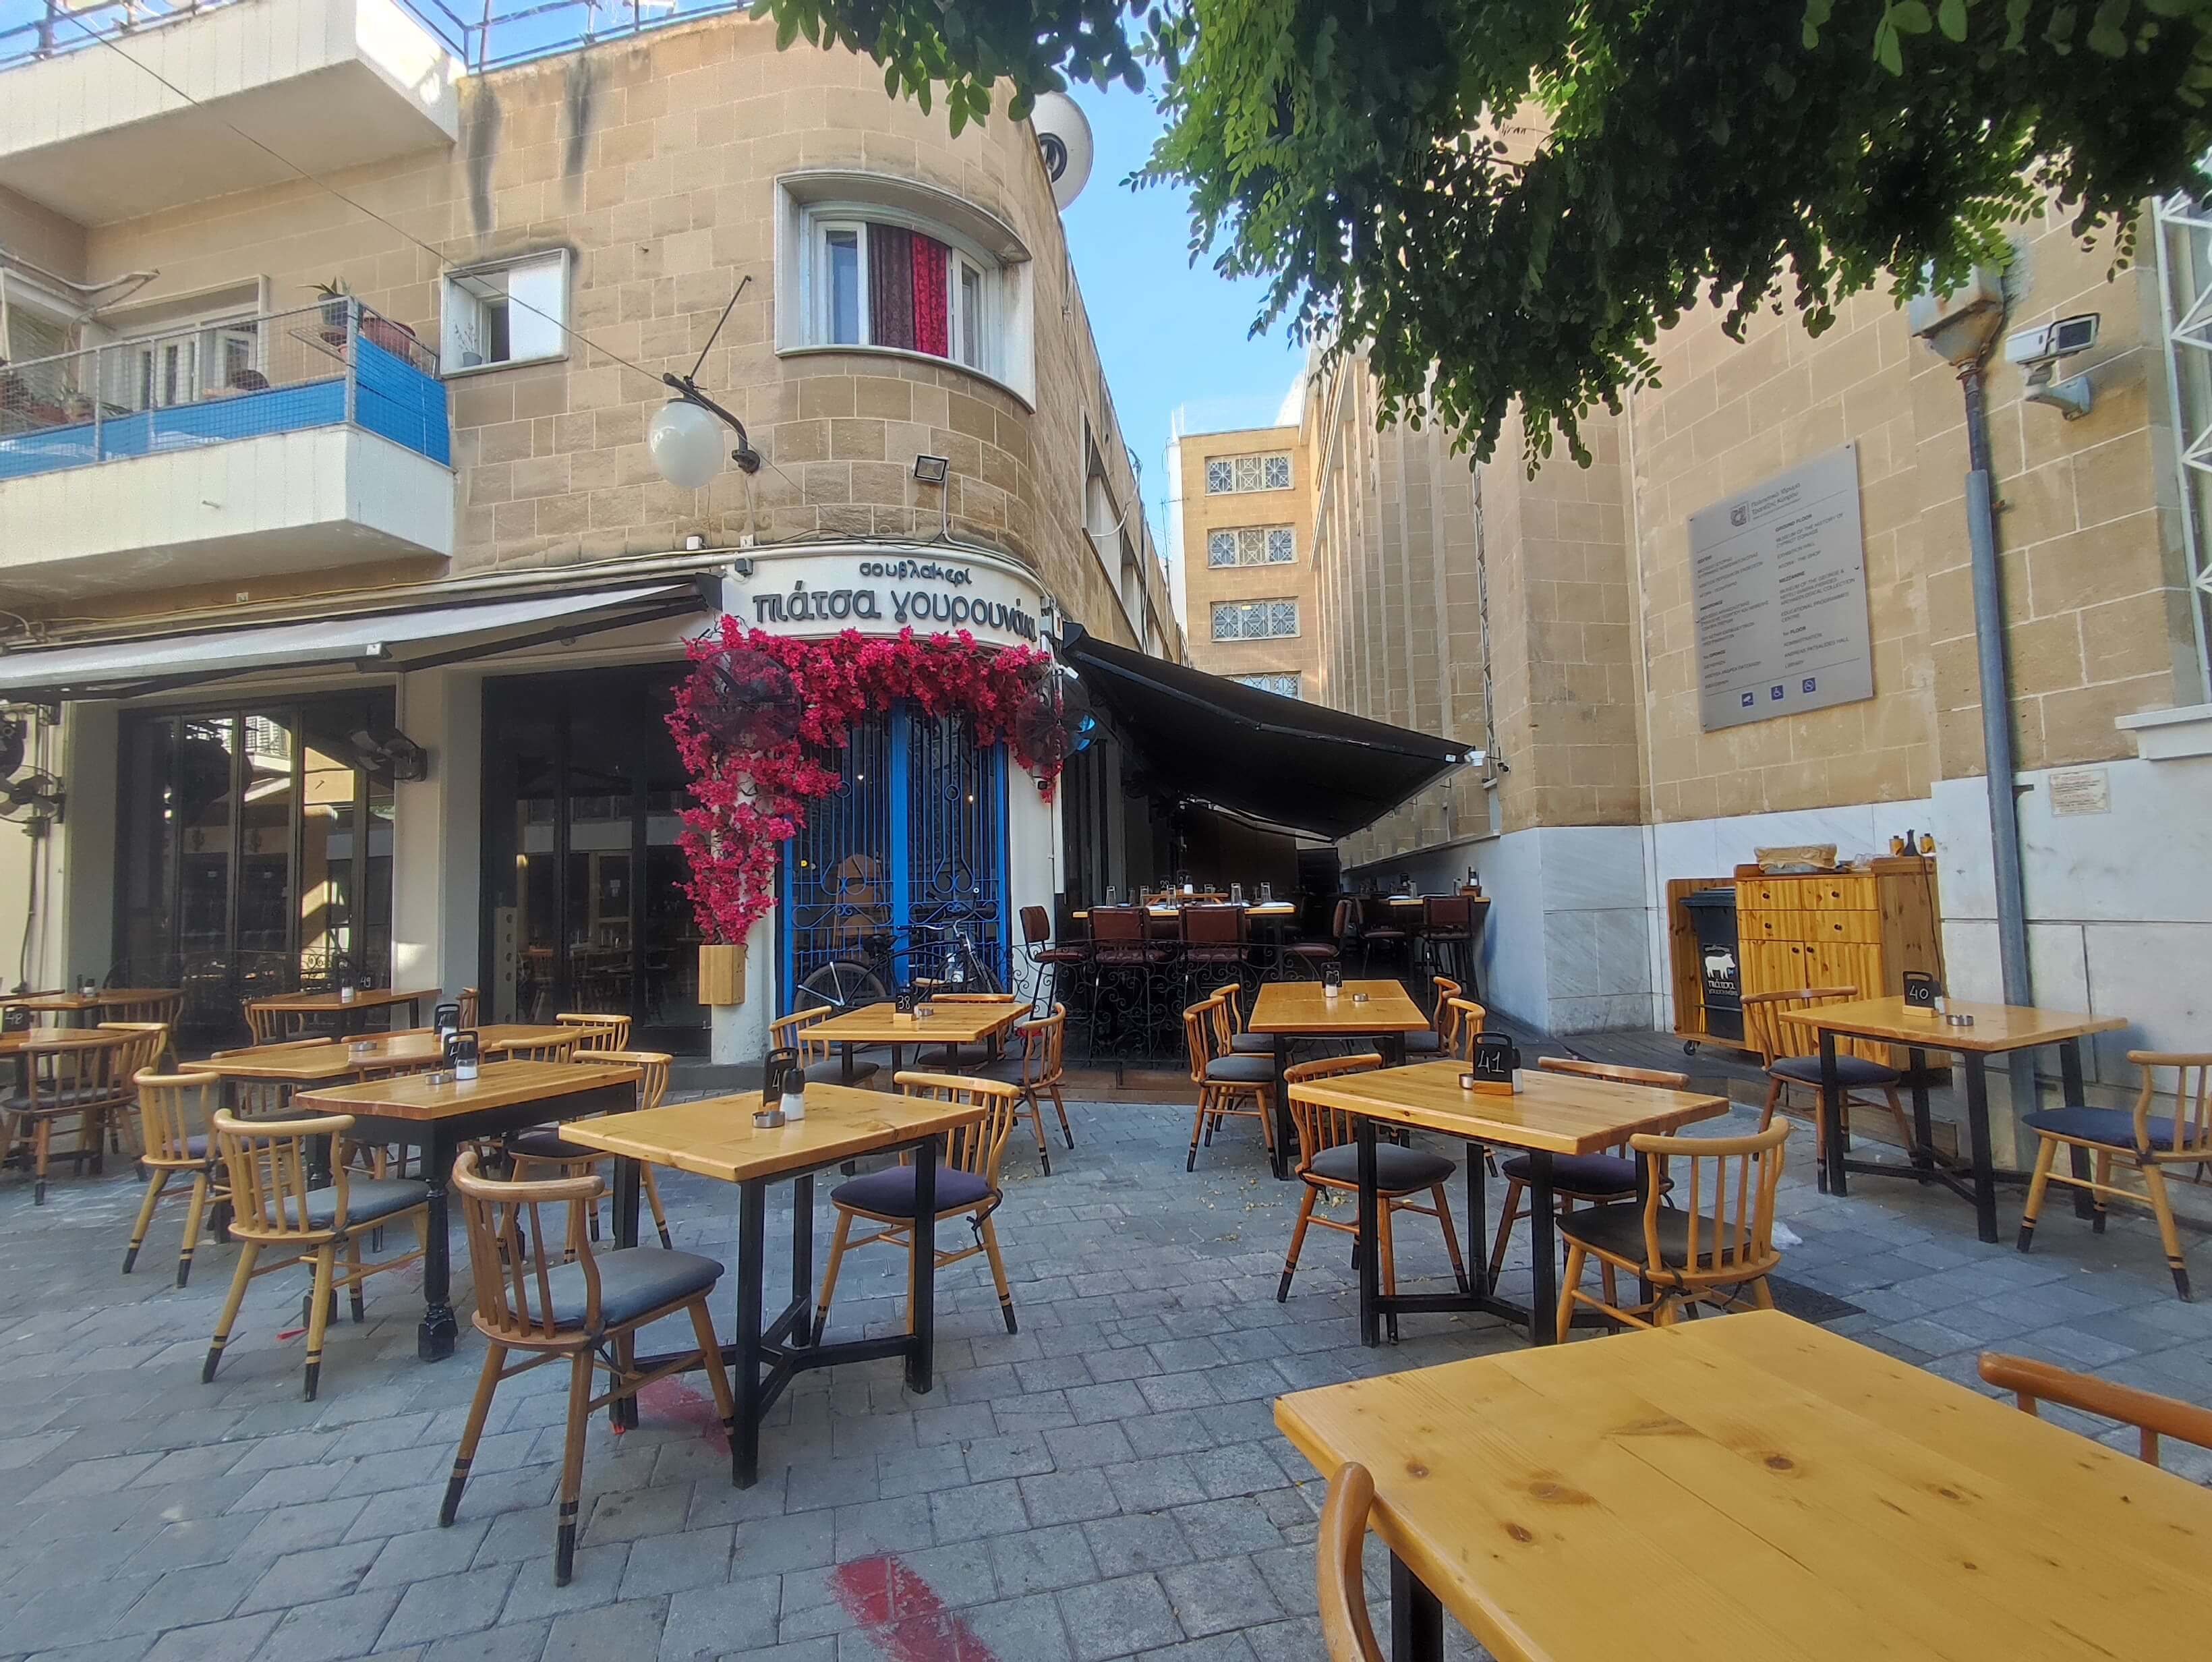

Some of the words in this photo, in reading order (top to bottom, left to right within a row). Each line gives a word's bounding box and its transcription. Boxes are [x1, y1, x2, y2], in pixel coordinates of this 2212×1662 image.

[1796, 514, 1813, 523] FLOOR
[859, 560, 972, 588] σουβλακερί
[753, 580, 881, 623] πιάτσα
[891, 590, 1037, 642] γουρουνάκι
[1790, 626, 1806, 634] FLOOR
[360, 976, 372, 987] 49
[1909, 985, 1929, 1000] 40
[898, 995, 910, 1010] 38
[5, 1012, 23, 1025] 48
[1478, 1050, 1505, 1074] 41
